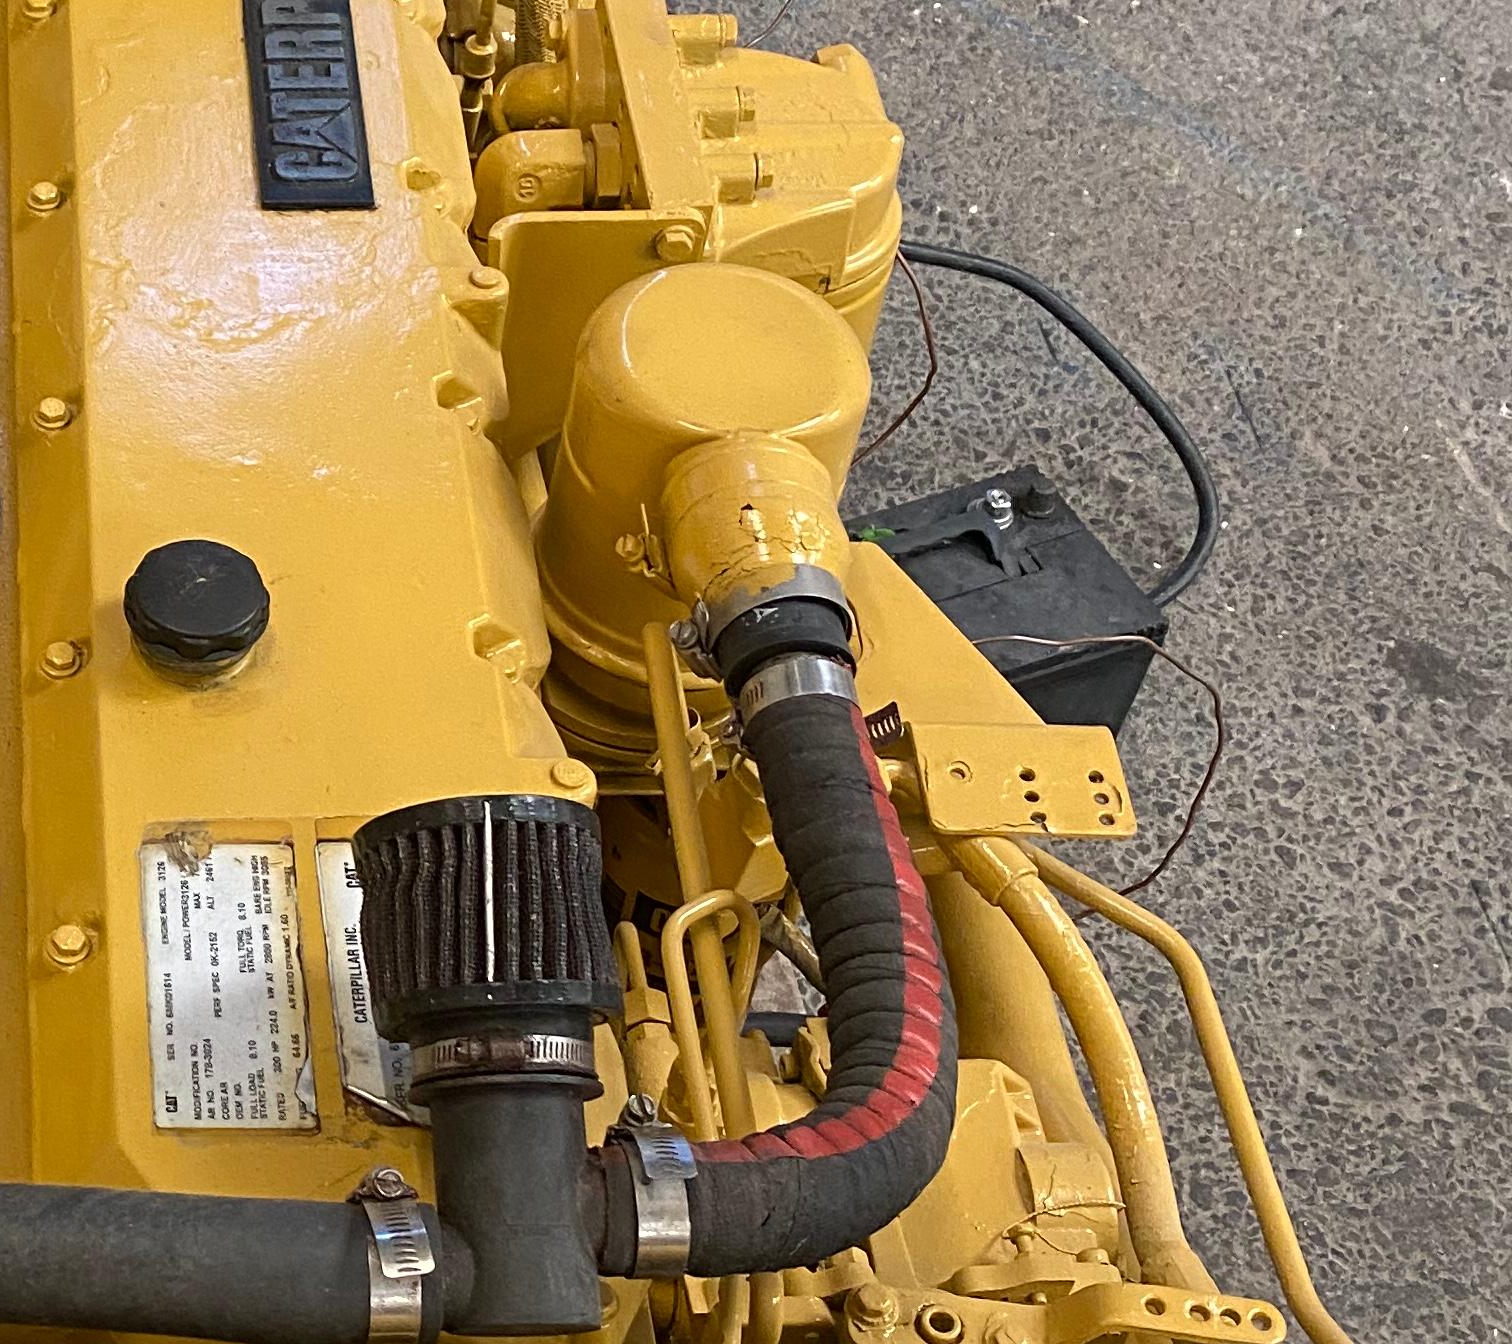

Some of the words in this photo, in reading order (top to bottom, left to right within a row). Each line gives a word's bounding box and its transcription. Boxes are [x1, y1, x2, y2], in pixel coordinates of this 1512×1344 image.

[157, 861, 166, 881] 3126
[250, 855, 258, 874] HIGH
[251, 876, 260, 891] ENG
[261, 879, 270, 894] RPM
[159, 888, 167, 914] MODEL
[193, 892, 201, 909] MAX
[206, 896, 215, 910] ALT
[253, 893, 262, 914] BARE
[262, 897, 272, 914] IDLE
[160, 916, 169, 944] ENGINE
[245, 926, 253, 945] FUEL
[261, 924, 270, 940] RPM
[344, 923, 358, 946] INC.
[183, 934, 192, 961] MODEL
[282, 934, 294, 970] DYNAMIC
[238, 954, 247, 973] FULL
[246, 947, 255, 973] STATIC
[212, 972, 220, 993] SPEC
[286, 972, 295, 995] RATIO
[347, 950, 368, 1023] CATERPILLAR
[213, 998, 222, 1017] PERF
[271, 1041, 279, 1053] HP
[220, 1082, 227, 1094] AR
[248, 1073, 257, 1096] LOAD
[256, 1068, 264, 1088] FUEL
[192, 1061, 201, 1120] MODIFICATION
[165, 1096, 177, 1112] CAT
[220, 1096, 230, 1120] CORE
[250, 1098, 258, 1119] FULL
[258, 1090, 268, 1119] STATIC
[277, 1093, 287, 1120] RATED
